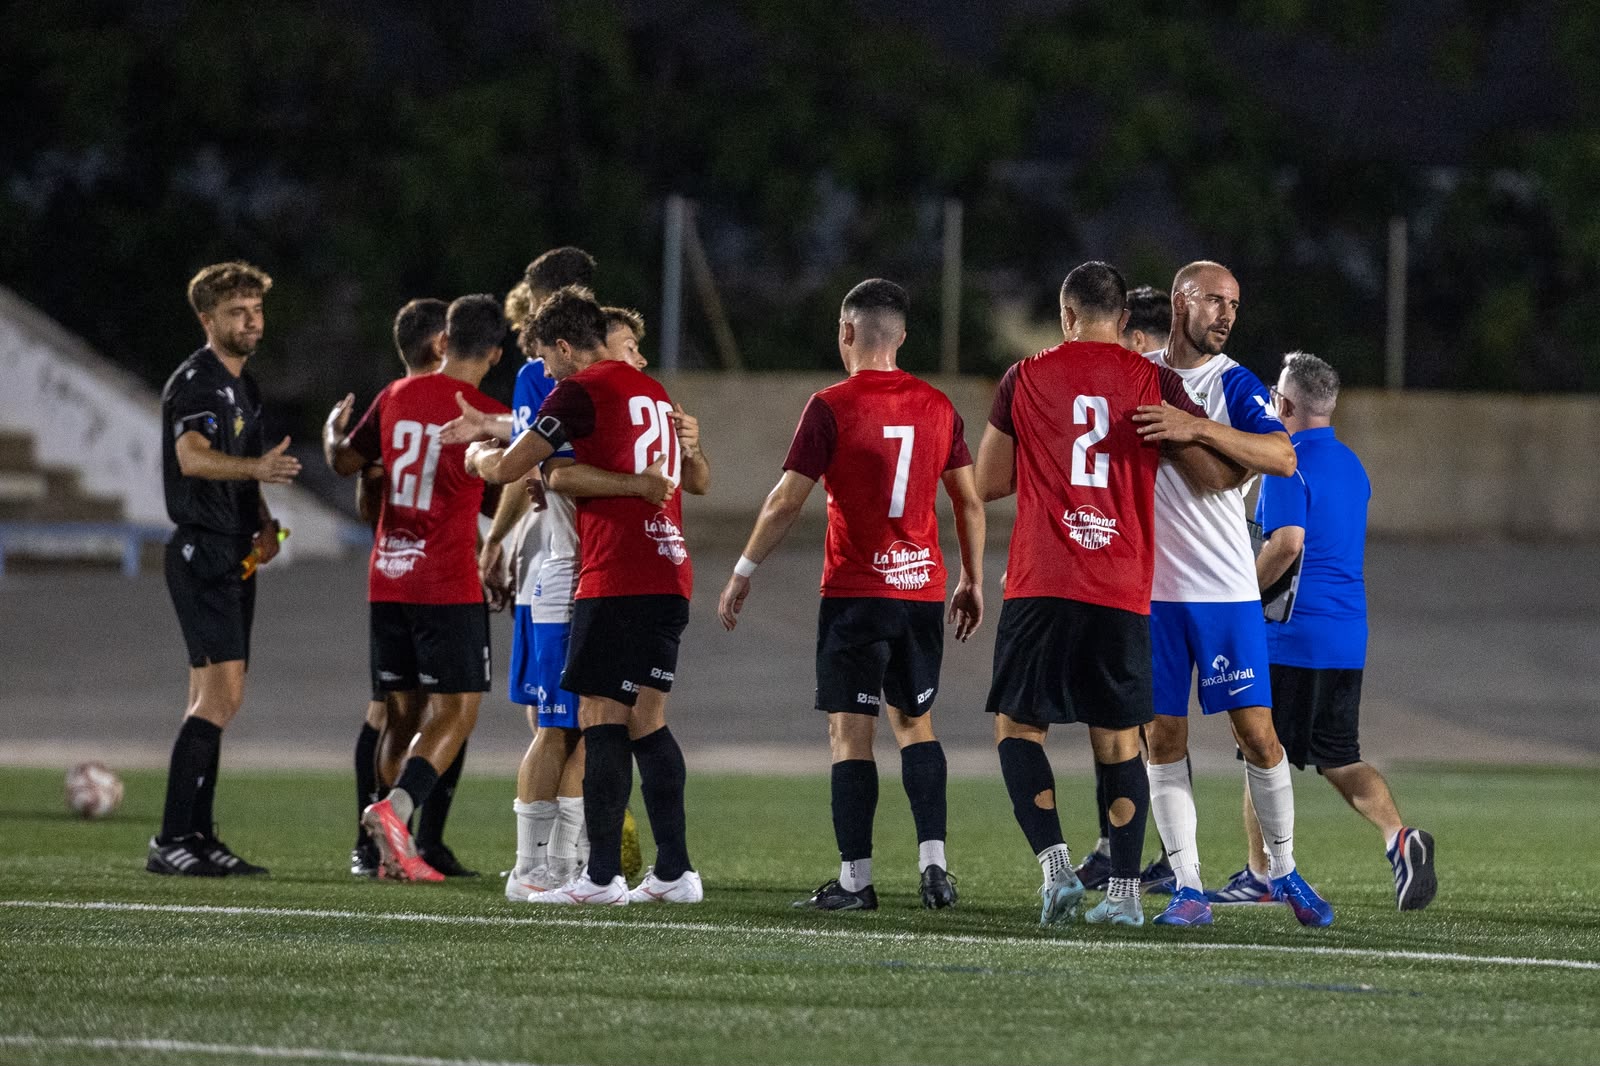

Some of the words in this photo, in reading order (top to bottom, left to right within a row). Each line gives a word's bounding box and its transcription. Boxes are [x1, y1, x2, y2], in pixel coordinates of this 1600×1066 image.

[389, 419, 443, 511] 21
[628, 395, 681, 489] 20
[883, 425, 915, 518] 7
[1070, 394, 1110, 489] 2
[873, 552, 890, 565] La
[890, 547, 931, 564] Tahona
[1063, 509, 1077, 521] La
[1077, 511, 1117, 528] Tahona
